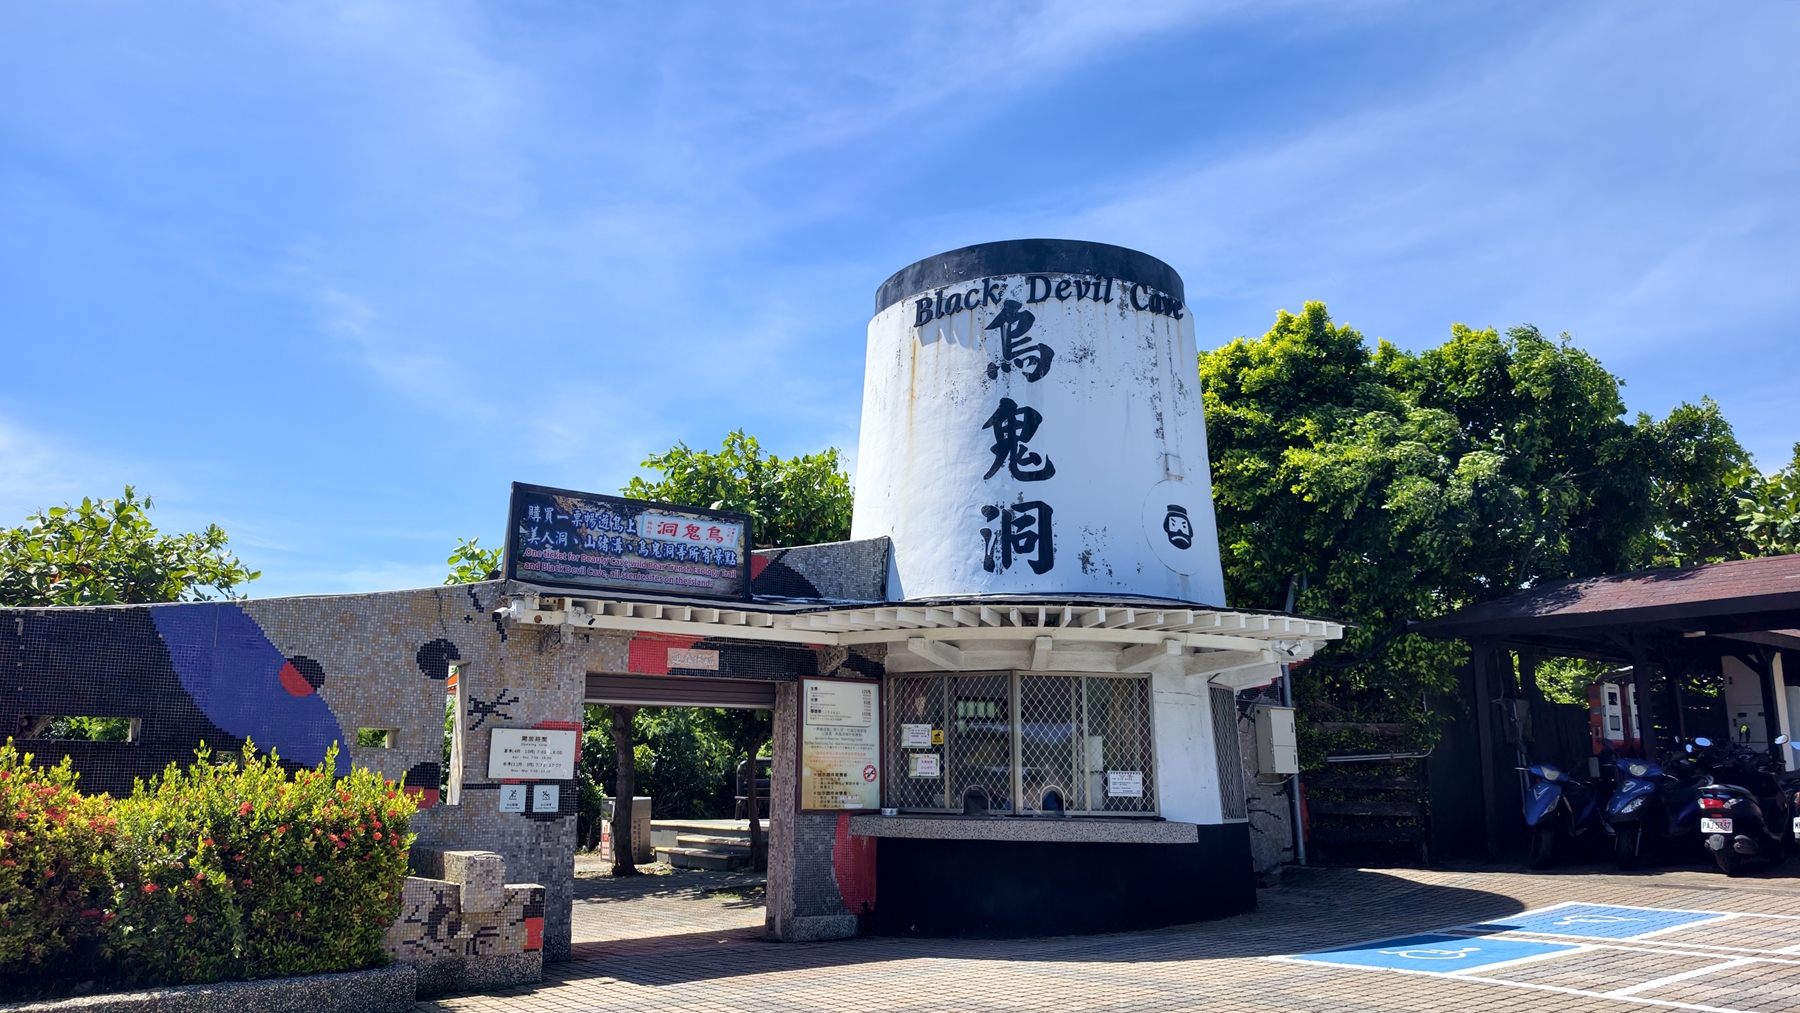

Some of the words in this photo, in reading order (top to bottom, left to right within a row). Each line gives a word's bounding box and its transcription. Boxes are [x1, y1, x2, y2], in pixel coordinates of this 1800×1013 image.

[914, 278, 1001, 328] Black
[1026, 273, 1114, 305] Devil
[1130, 282, 1184, 321] Cave
[980, 299, 1056, 575] 烏鬼洞
[528, 505, 637, 533] 購買一票暢遊島上
[524, 562, 540, 570] and
[542, 562, 564, 572] Black
[566, 565, 586, 575] Devil
[588, 567, 609, 578] Cave,
[610, 570, 620, 578] all
[621, 572, 644, 581] scenic
[646, 573, 663, 582] sites
[675, 575, 688, 585] the
[688, 577, 713, 587] island.
[525, 547, 541, 558] One
[543, 550, 567, 560] ticket
[568, 552, 580, 562] for
[581, 554, 608, 566] Beauty
[648, 561, 665, 571] Boar
[667, 564, 691, 573] Trench
[693, 566, 719, 578] Ecology
[721, 569, 737, 579] Trail
